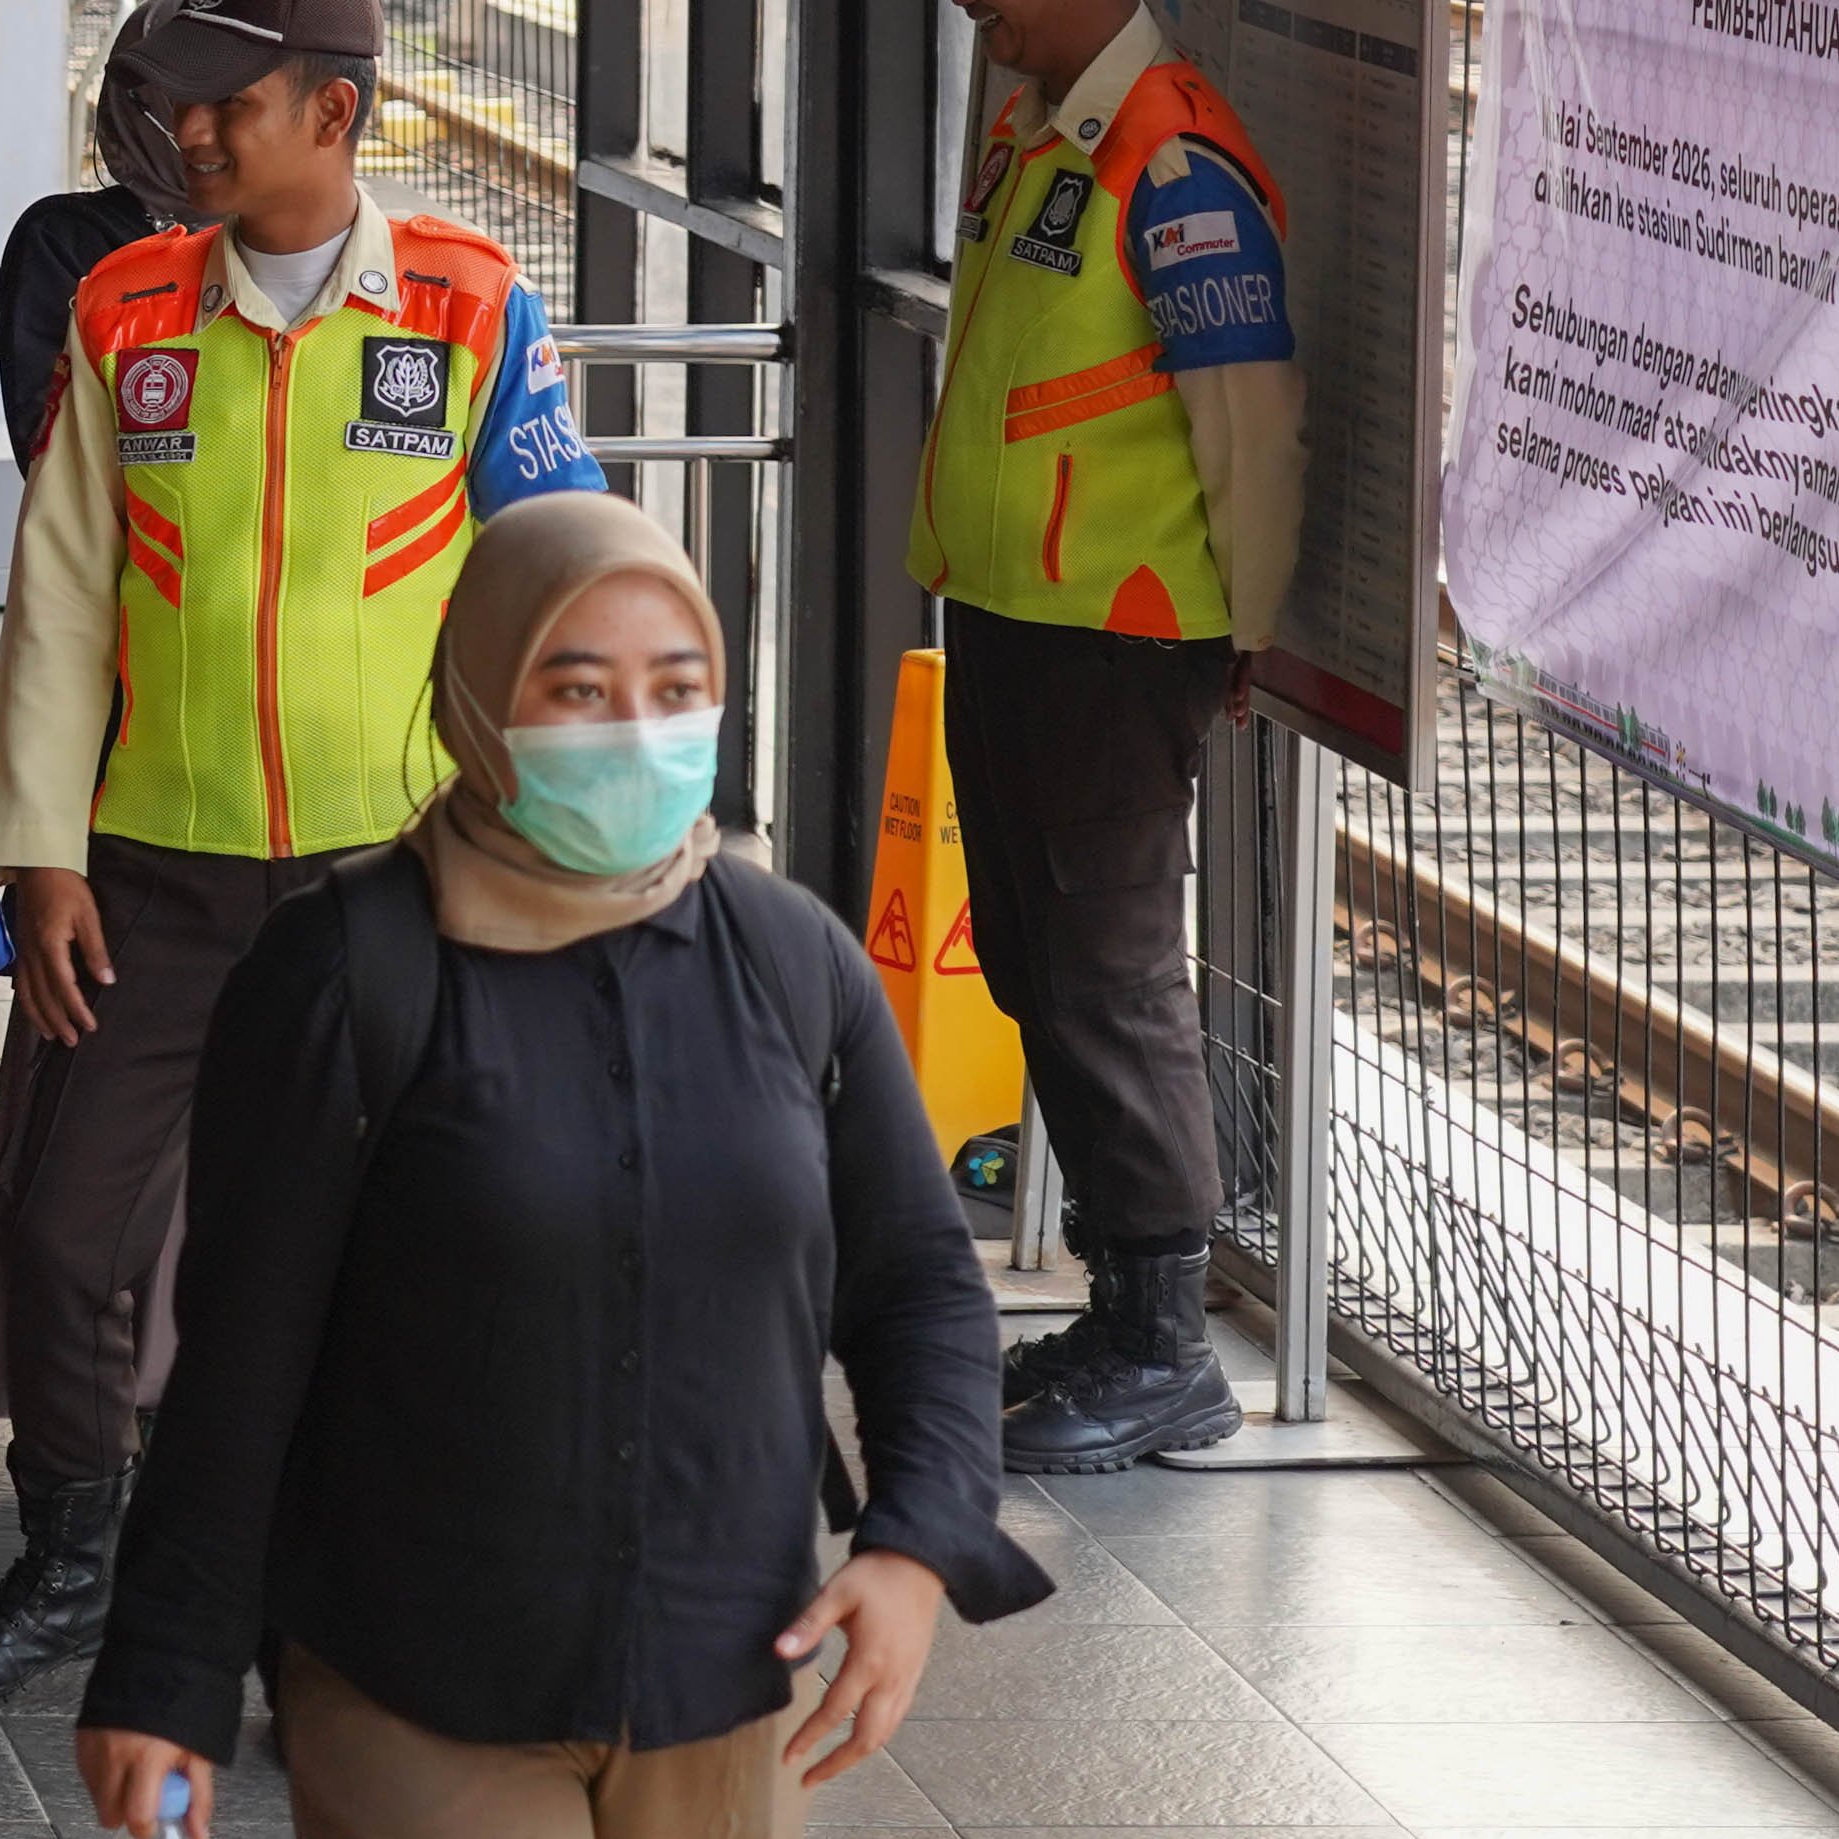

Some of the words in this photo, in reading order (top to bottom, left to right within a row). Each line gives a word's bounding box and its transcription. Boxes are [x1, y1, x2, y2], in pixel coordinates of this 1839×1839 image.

[1586, 107, 1668, 172] September
[1672, 138, 1715, 201] 2026,
[1720, 152, 1779, 213] seluruh
[1787, 181, 1839, 232] opera
[1177, 238, 1234, 256] Commuter
[1616, 181, 1634, 232] ke
[1638, 197, 1691, 252] stasiun
[1695, 209, 1773, 280] Sudirman
[1014, 240, 1073, 274] SATPAM
[1150, 273, 1276, 338] STASIONER
[1512, 284, 1628, 367] Sehubungan
[1632, 322, 1694, 390] dengan
[1504, 345, 1558, 404] kami
[1558, 372, 1616, 426] mohon
[1616, 397, 1664, 444] maaf
[122, 437, 182, 452] ANWAR
[356, 428, 449, 455] SATPAM
[1497, 416, 1562, 475] selama
[1560, 446, 1626, 496] proses
[1707, 486, 1754, 533] ini
[890, 792, 920, 817] CAUTION
[885, 816, 899, 837] WET
[900, 820, 922, 843] FLOOR
[940, 826, 961, 844] WE
